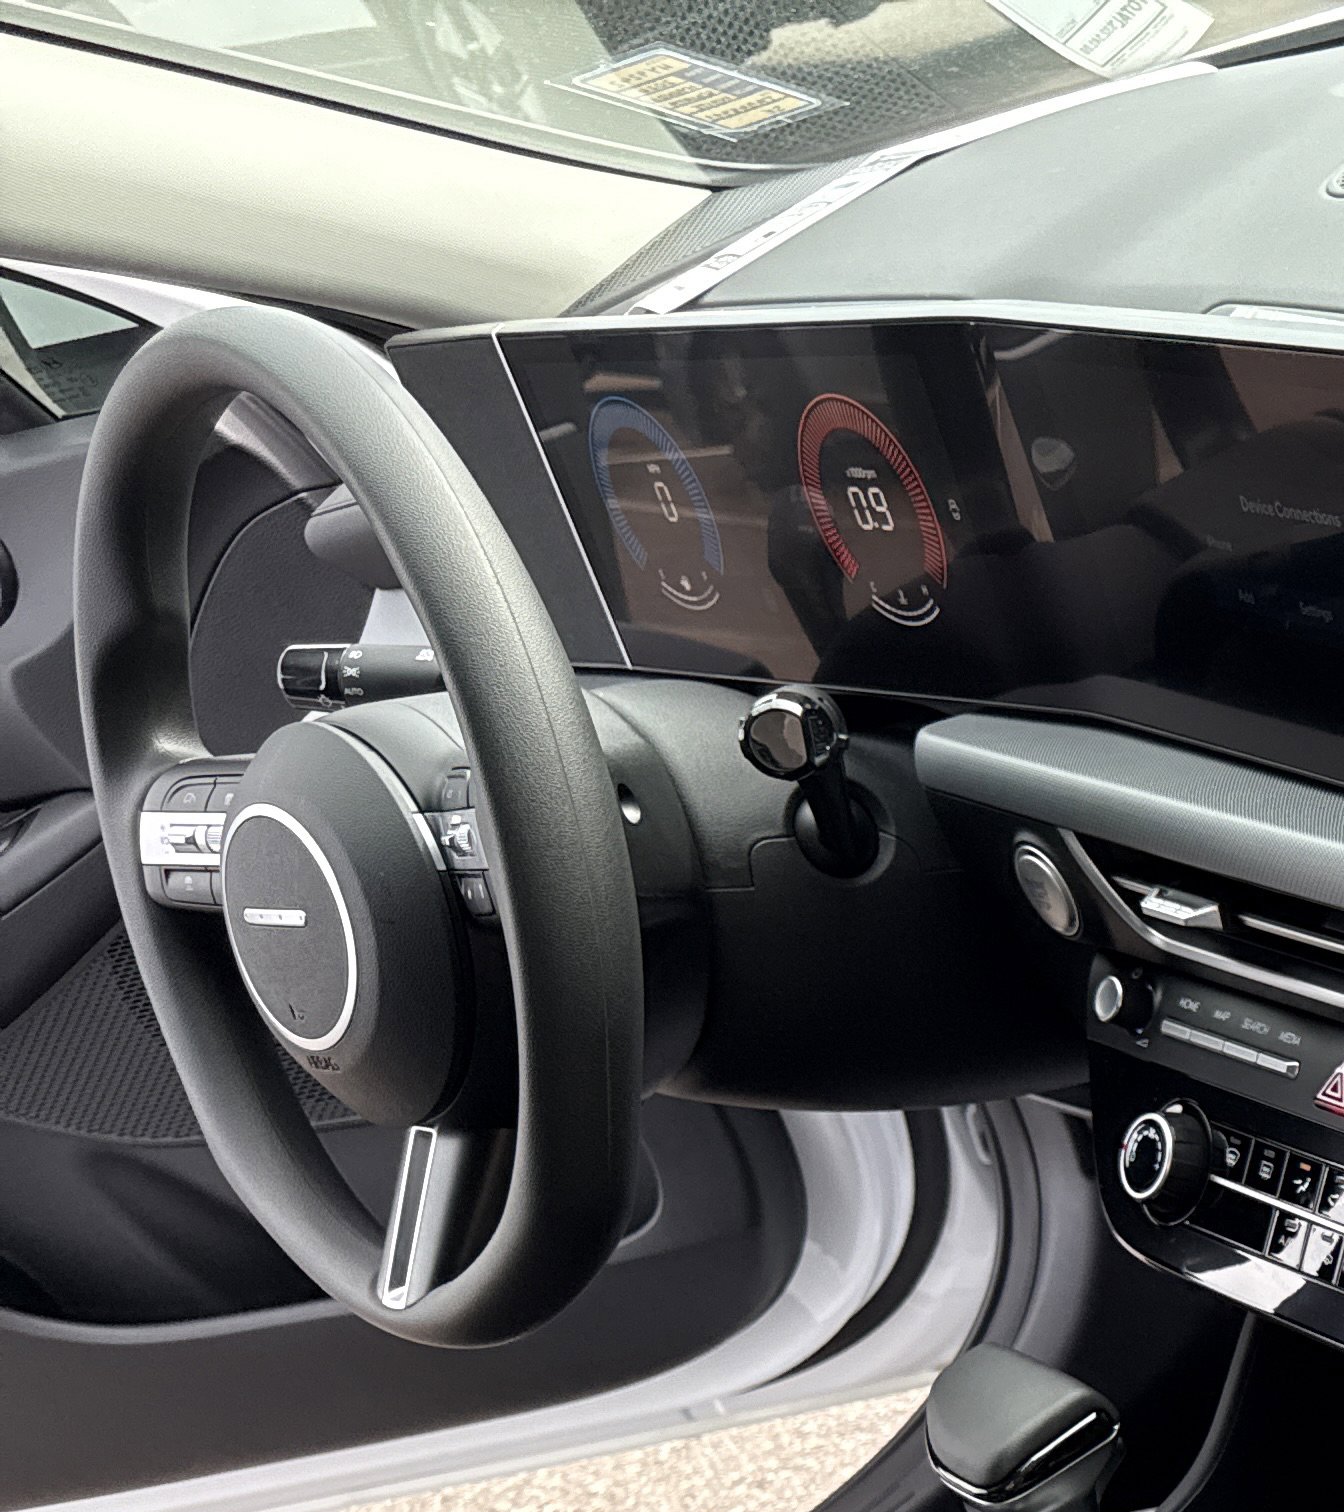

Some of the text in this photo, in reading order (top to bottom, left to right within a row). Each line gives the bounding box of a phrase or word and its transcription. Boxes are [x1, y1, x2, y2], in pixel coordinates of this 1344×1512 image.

[653, 481, 679, 523] 0
[846, 486, 895, 531] 0.9
[1239, 495, 1342, 528] Device Connections
